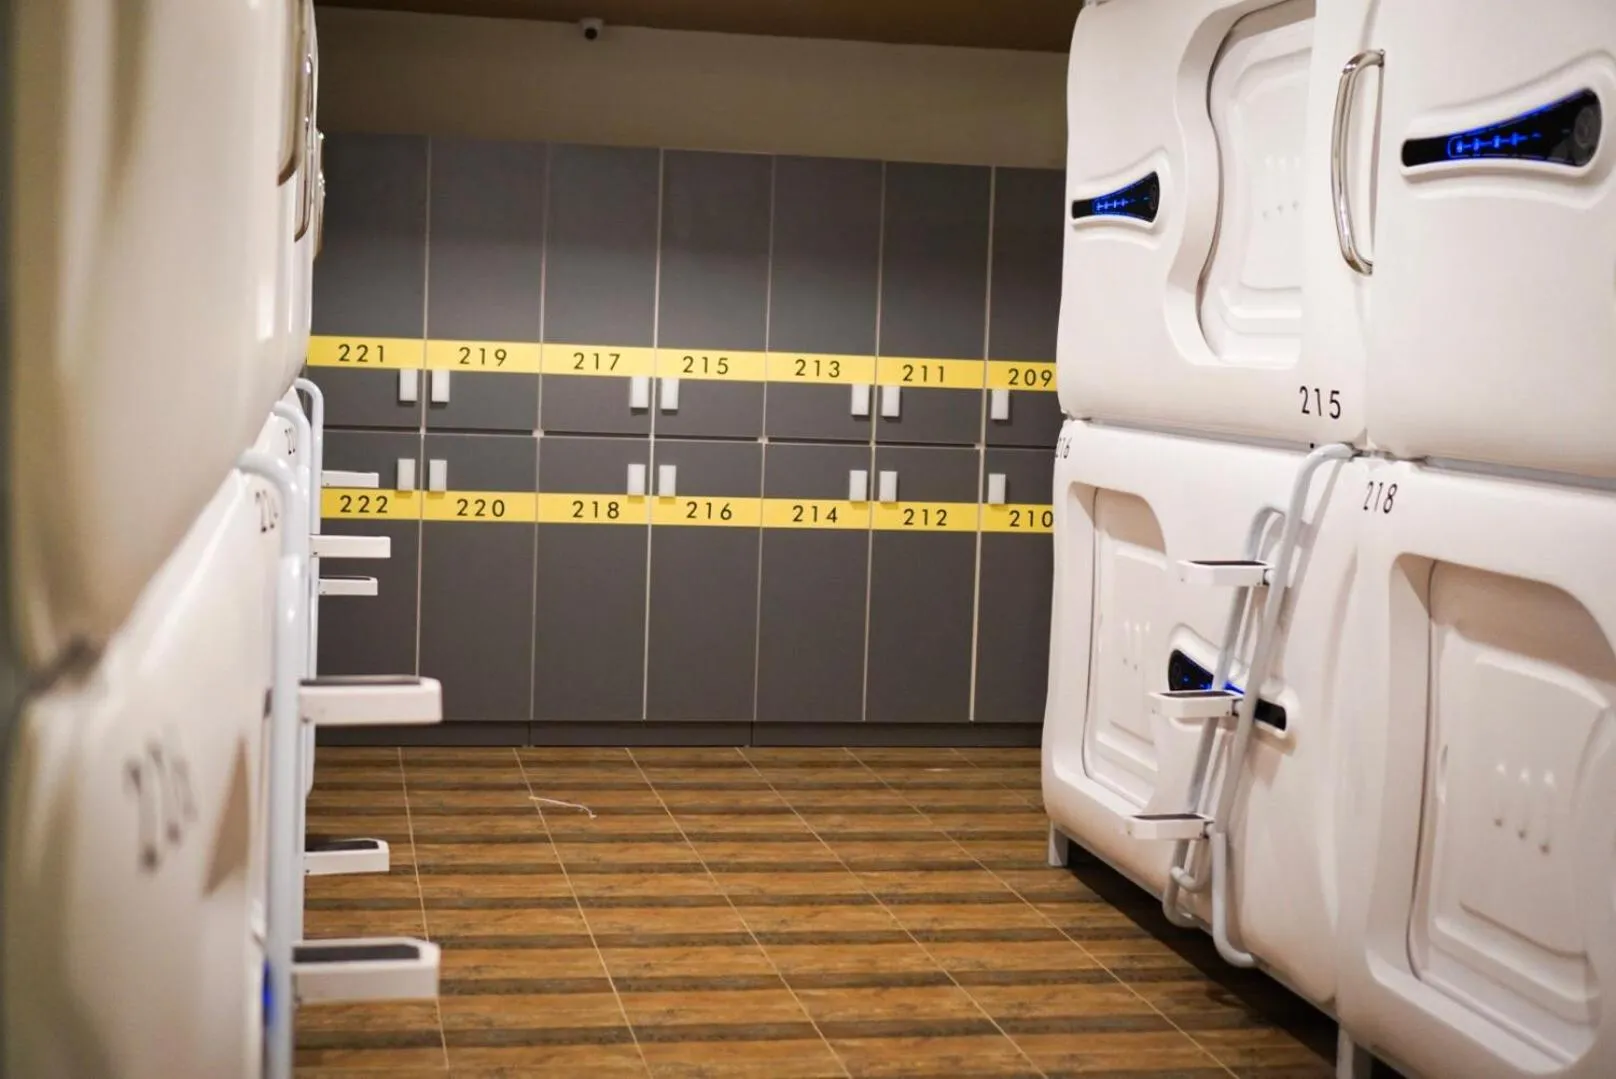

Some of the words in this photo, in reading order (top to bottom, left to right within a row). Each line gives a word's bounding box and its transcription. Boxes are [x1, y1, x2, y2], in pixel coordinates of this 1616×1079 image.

[338, 344, 384, 363] 221
[458, 346, 507, 367] 219
[573, 352, 621, 372] 217
[682, 355, 729, 375] 215
[794, 358, 841, 378] 213
[902, 364, 945, 383] 211
[1008, 368, 1053, 387] 209
[1299, 385, 1341, 419] 215
[339, 494, 389, 514] 222
[1363, 480, 1398, 514] 218
[456, 499, 505, 518] 220
[572, 500, 620, 519] 218
[686, 501, 733, 520] 216
[792, 505, 839, 524] 214
[902, 508, 948, 527] 212
[1009, 510, 1054, 529] 210
